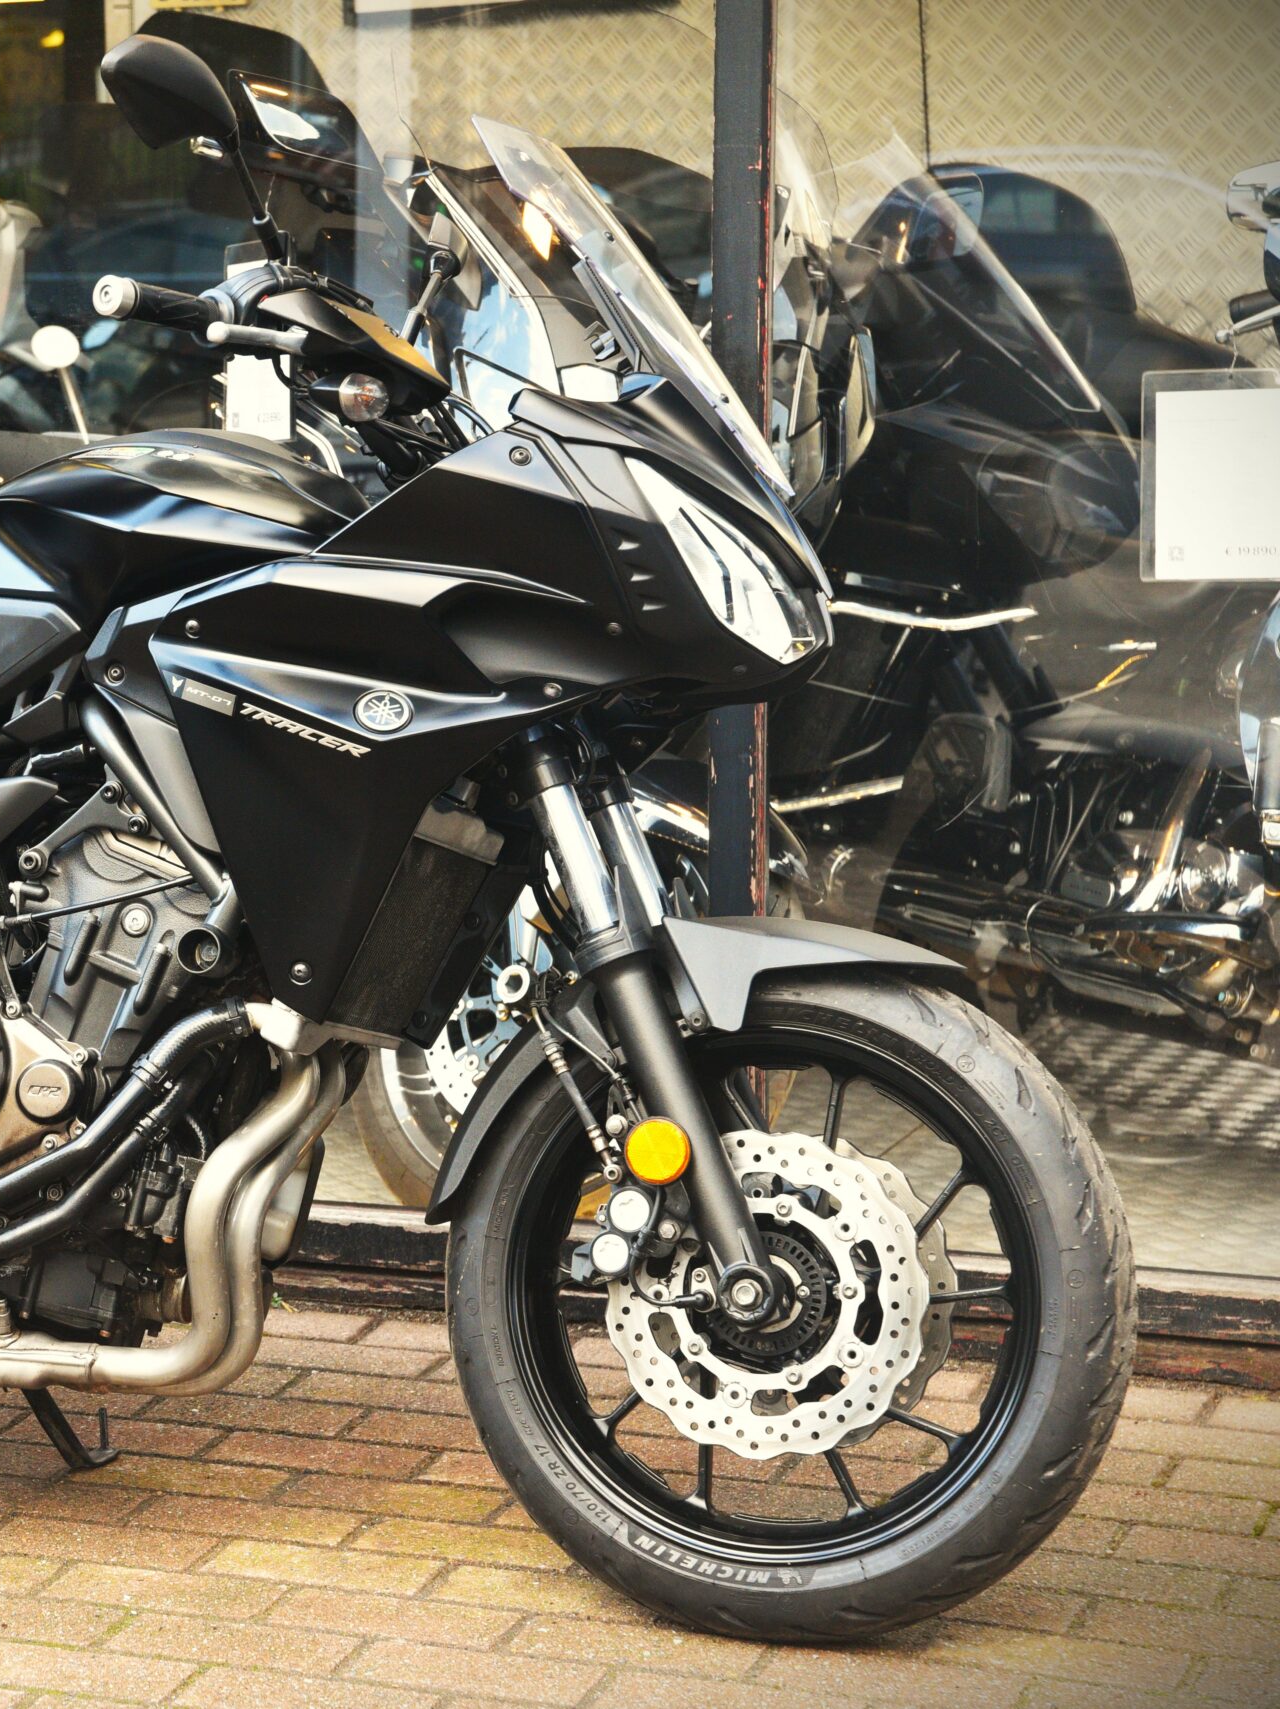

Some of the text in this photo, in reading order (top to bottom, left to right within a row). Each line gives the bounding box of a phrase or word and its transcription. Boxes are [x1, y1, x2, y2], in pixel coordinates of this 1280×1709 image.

[187, 686, 233, 706] MT-07
[239, 702, 372, 759] TRACER
[534, 1443, 551, 1459] 17
[547, 1460, 572, 1479] ZR
[565, 1481, 610, 1524] 120/70
[634, 1533, 771, 1585] MICHELIN
